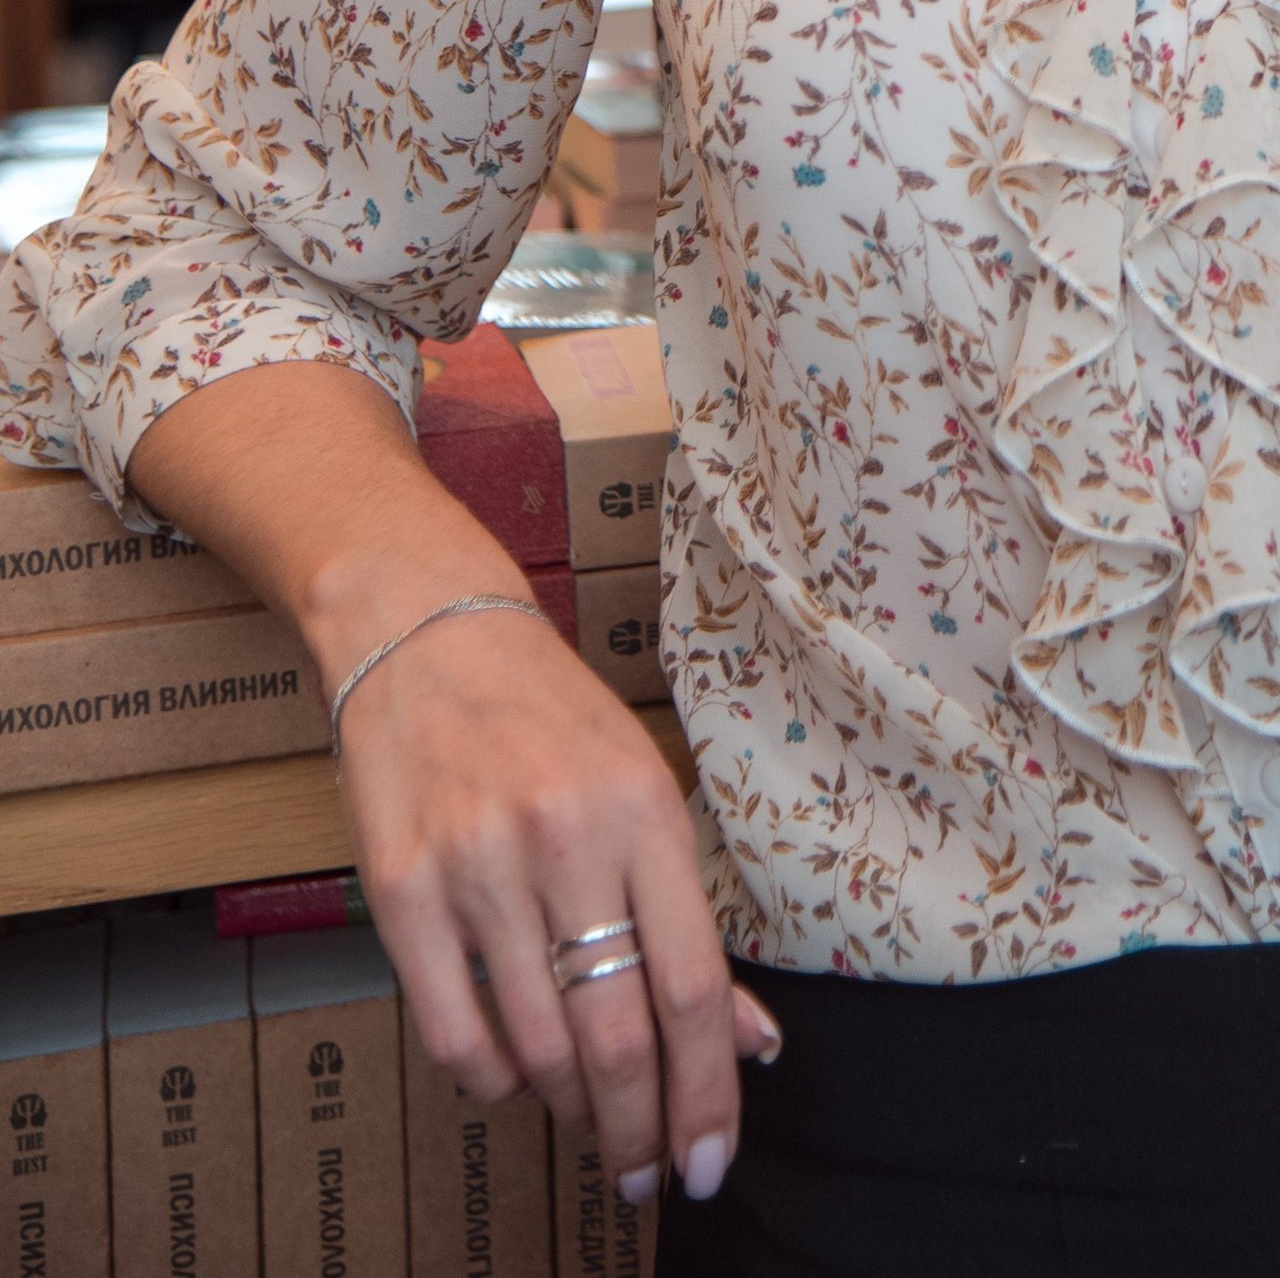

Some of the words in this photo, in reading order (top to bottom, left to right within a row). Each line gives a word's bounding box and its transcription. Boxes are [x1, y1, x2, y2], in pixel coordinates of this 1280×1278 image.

[159, 669, 299, 713] ВЛИЯНИЯ
[165, 1104, 193, 1123] THE
[16, 1132, 45, 1152] THE
[162, 1127, 197, 1148] BEST
[12, 1155, 48, 1176] BEST
